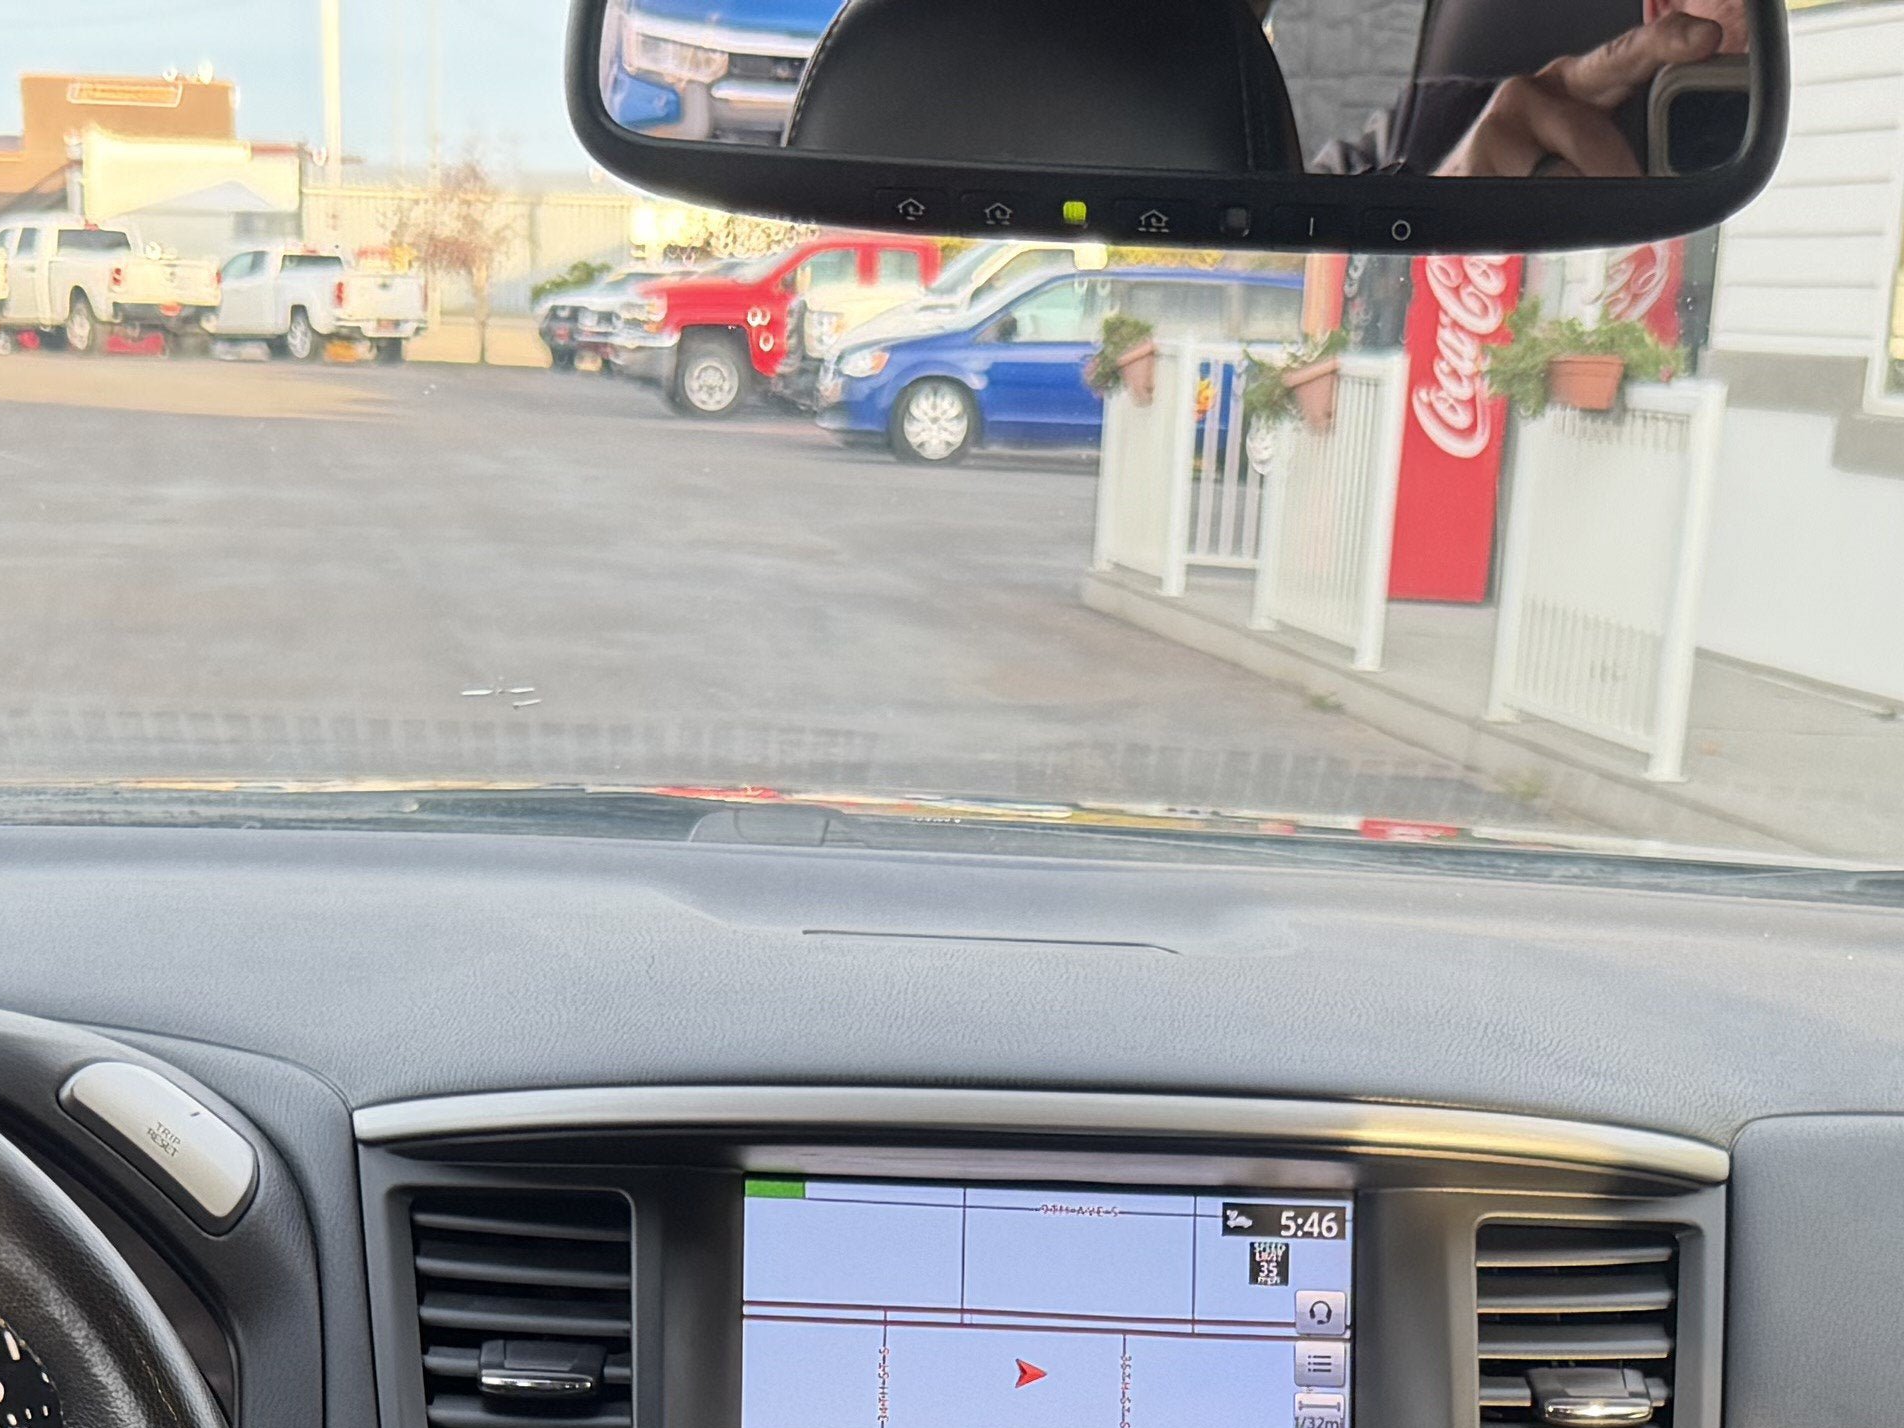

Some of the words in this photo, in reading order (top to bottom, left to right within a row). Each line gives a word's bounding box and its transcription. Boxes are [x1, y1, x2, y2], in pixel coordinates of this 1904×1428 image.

[147, 1129, 179, 1157] RESET
[156, 1121, 182, 1145] TRIP
[1280, 1211, 1338, 1237] 5:46
[1259, 1261, 1277, 1277] 35
